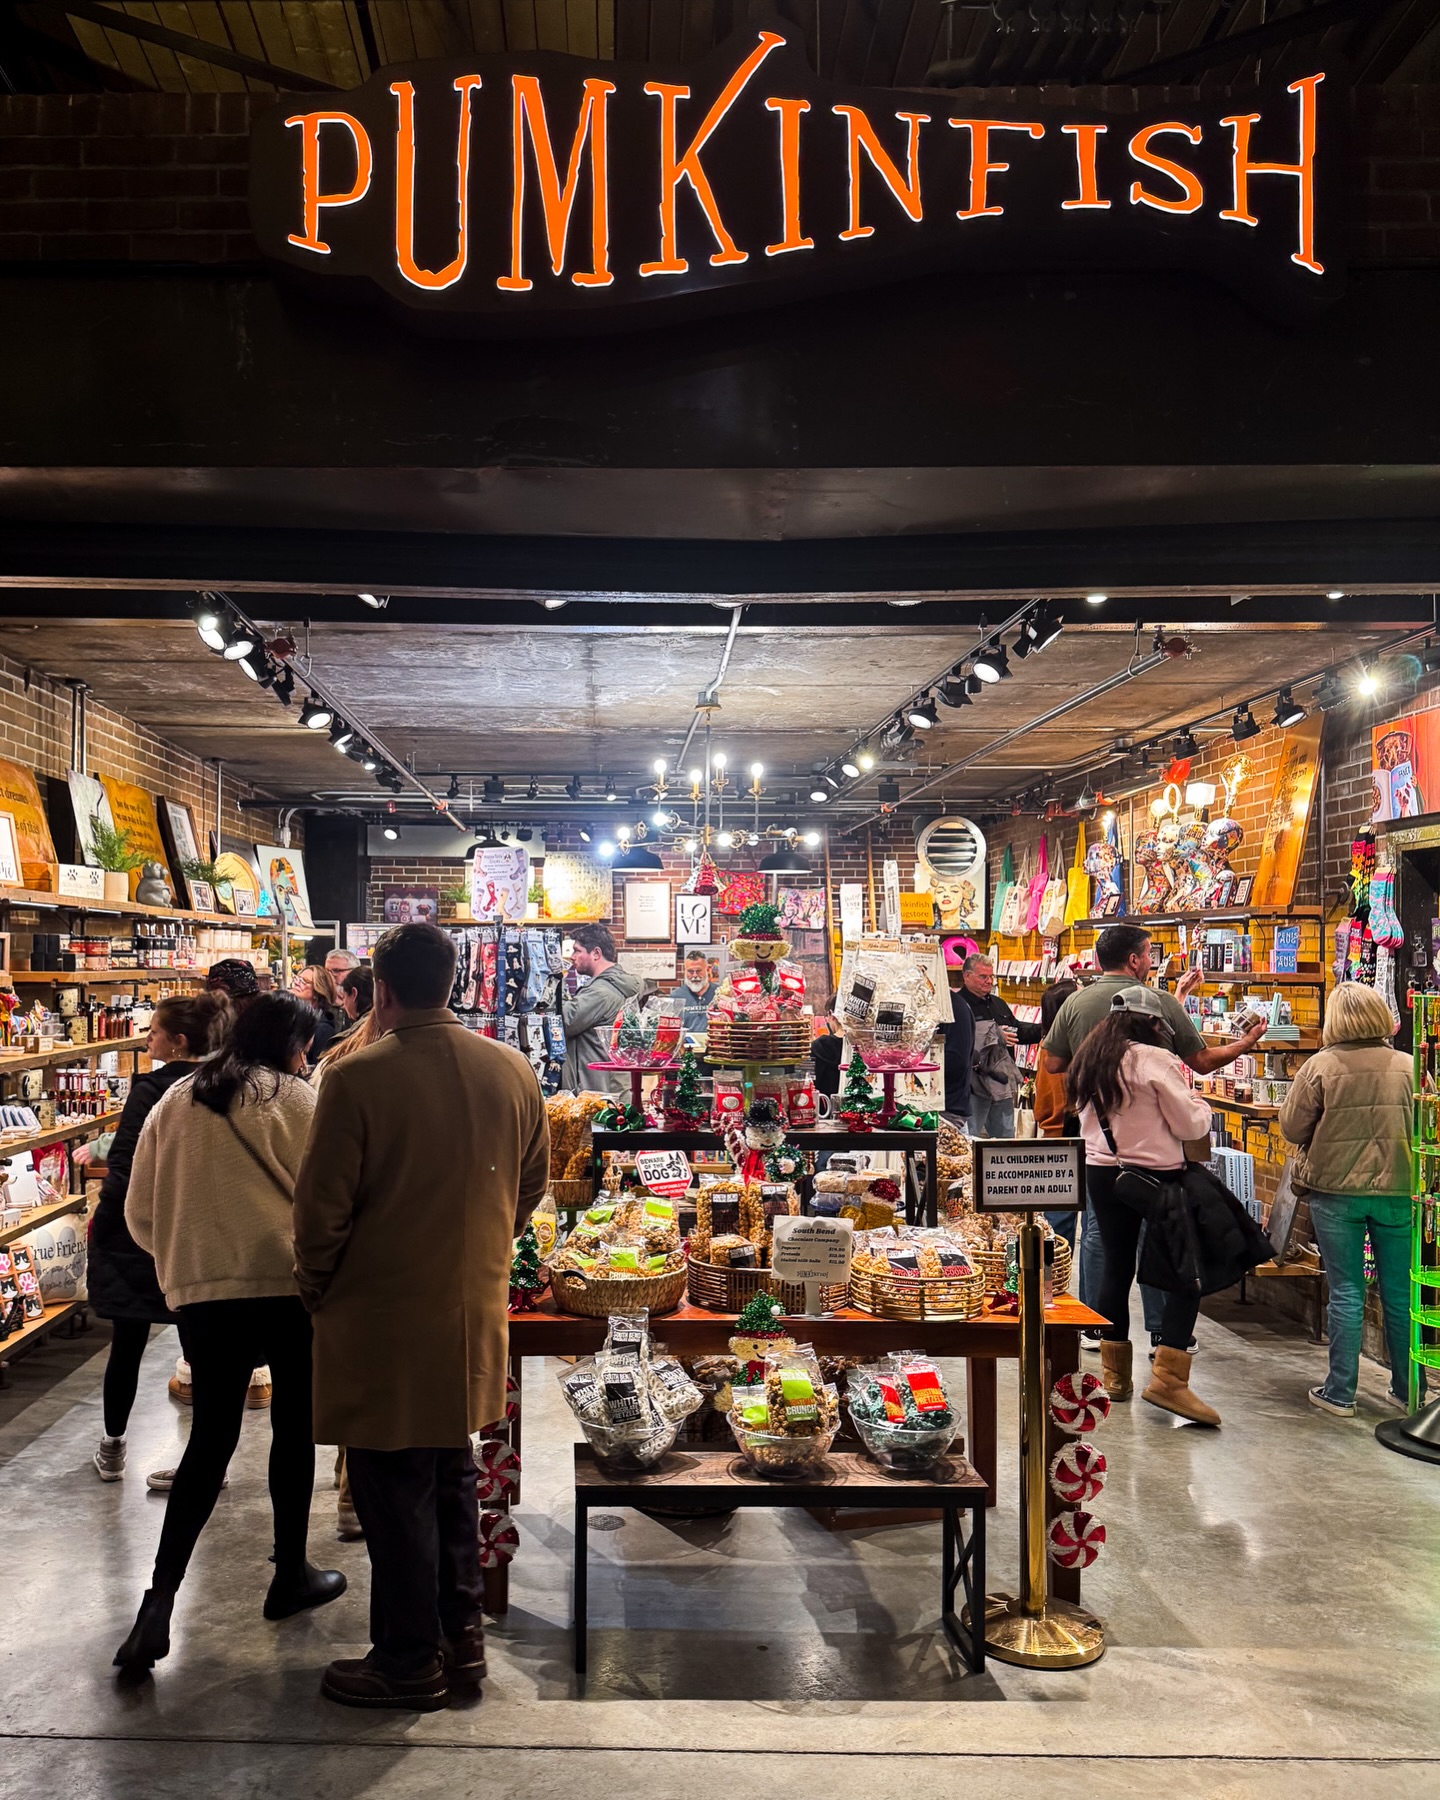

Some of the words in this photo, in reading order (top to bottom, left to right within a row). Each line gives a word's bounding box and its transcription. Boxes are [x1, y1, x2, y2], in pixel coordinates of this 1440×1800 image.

[285, 32, 1325, 291] PUMKINFISH
[848, 995, 870, 1008] WHITE
[876, 1023, 902, 1032] WHITE
[640, 1157, 665, 1165] BEWARE
[990, 1156, 1005, 1164] ALL
[1006, 1155, 1045, 1164] CHILDREN
[1047, 1154, 1068, 1163] MUST
[643, 1168, 670, 1181] DOG
[985, 1171, 996, 1179] BE
[998, 1170, 1053, 1179] ACCOMPANIED
[1055, 1170, 1066, 1178] BY
[1067, 1169, 1074, 1177] A
[987, 1186, 1018, 1194] PARENT
[1020, 1185, 1032, 1194] OR
[1034, 1185, 1045, 1193] AN
[1047, 1184, 1073, 1193] ADULT
[30, 1245, 54, 1260] rue
[608, 1397, 638, 1408] WHITE
[915, 1395, 946, 1405] PRETZELS
[611, 1410, 640, 1419] PRETZELS
[786, 1405, 817, 1416] CRUNCH
[745, 1429, 771, 1440] CRUNC
